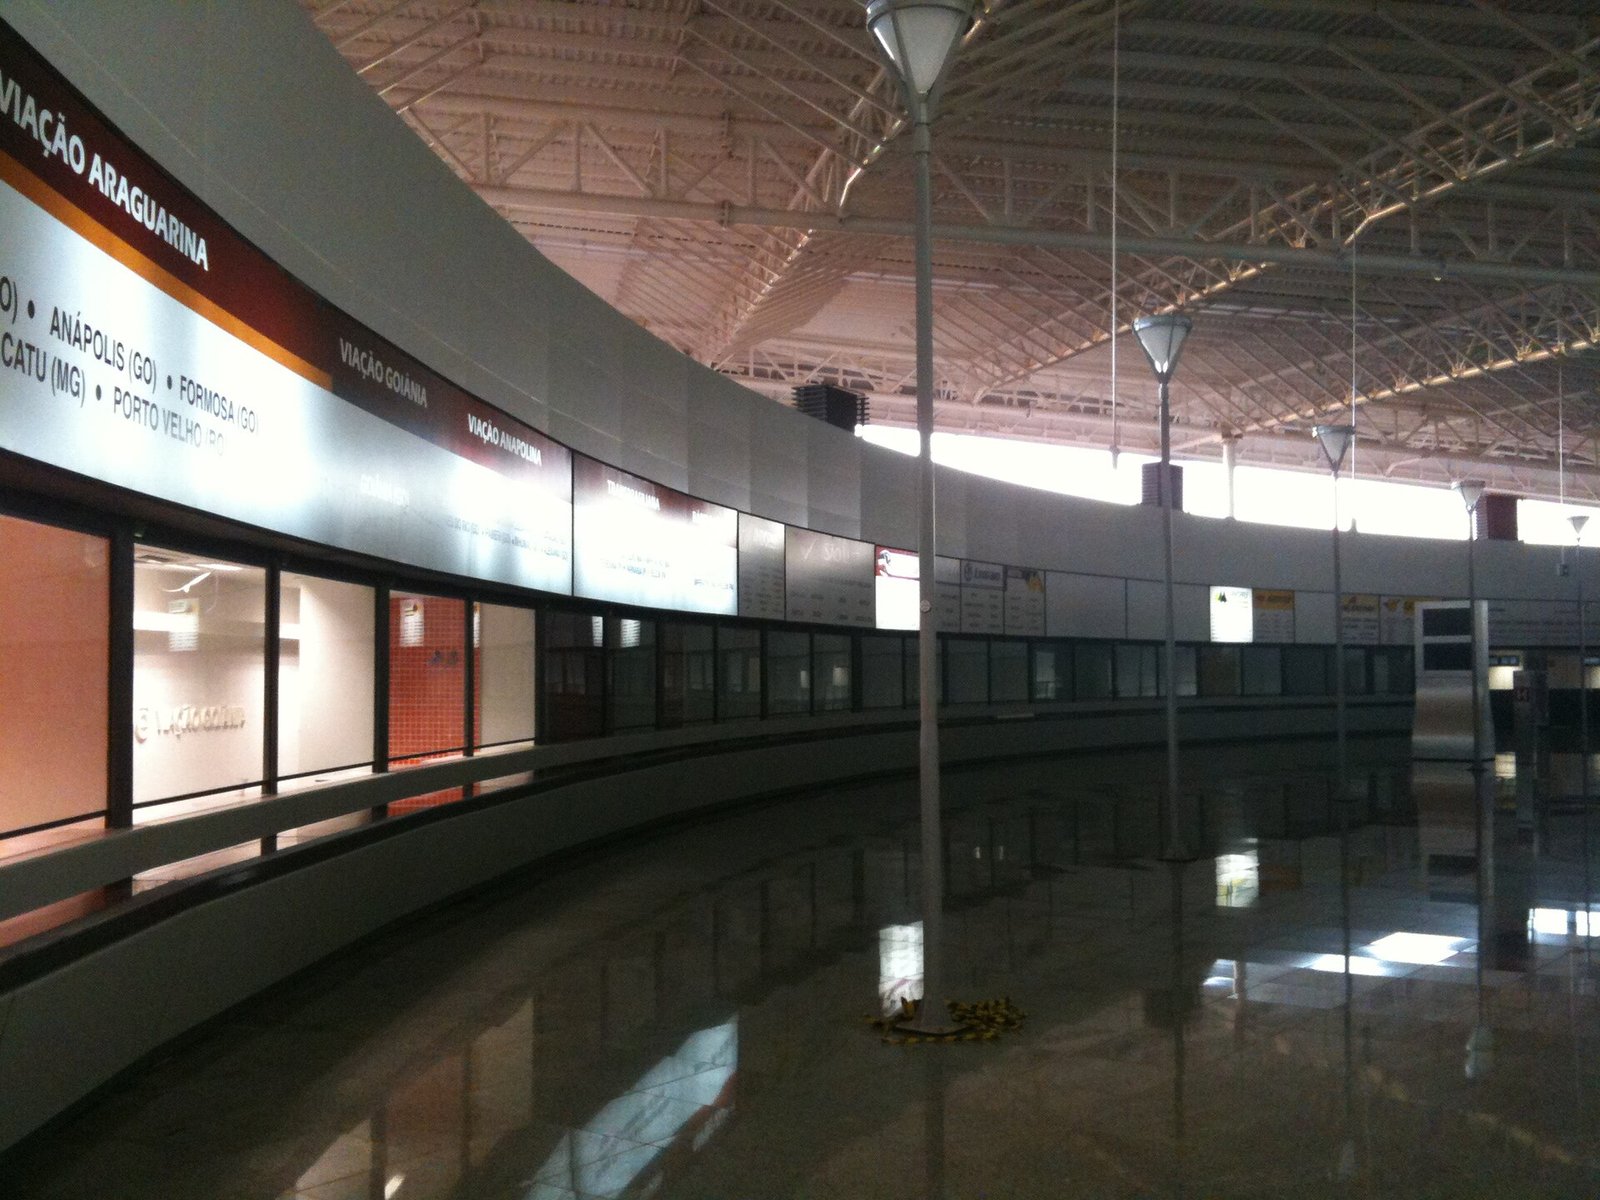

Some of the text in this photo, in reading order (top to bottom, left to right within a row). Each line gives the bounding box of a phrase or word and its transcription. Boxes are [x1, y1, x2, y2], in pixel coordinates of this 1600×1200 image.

[0, 71, 208, 271] VIAÇÃO ARAGUARINA
[1, 332, 46, 382] CATU
[51, 356, 85, 407] (MG)
[114, 387, 158, 431] PORTO
[162, 407, 202, 448] VELHO
[50, 306, 125, 371] ANÁPOLIS
[129, 348, 156, 393] (GO)
[180, 375, 234, 421] FORMOSA
[340, 338, 383, 382] VIAÇÃO
[468, 413, 499, 445] VIAÇÃO
